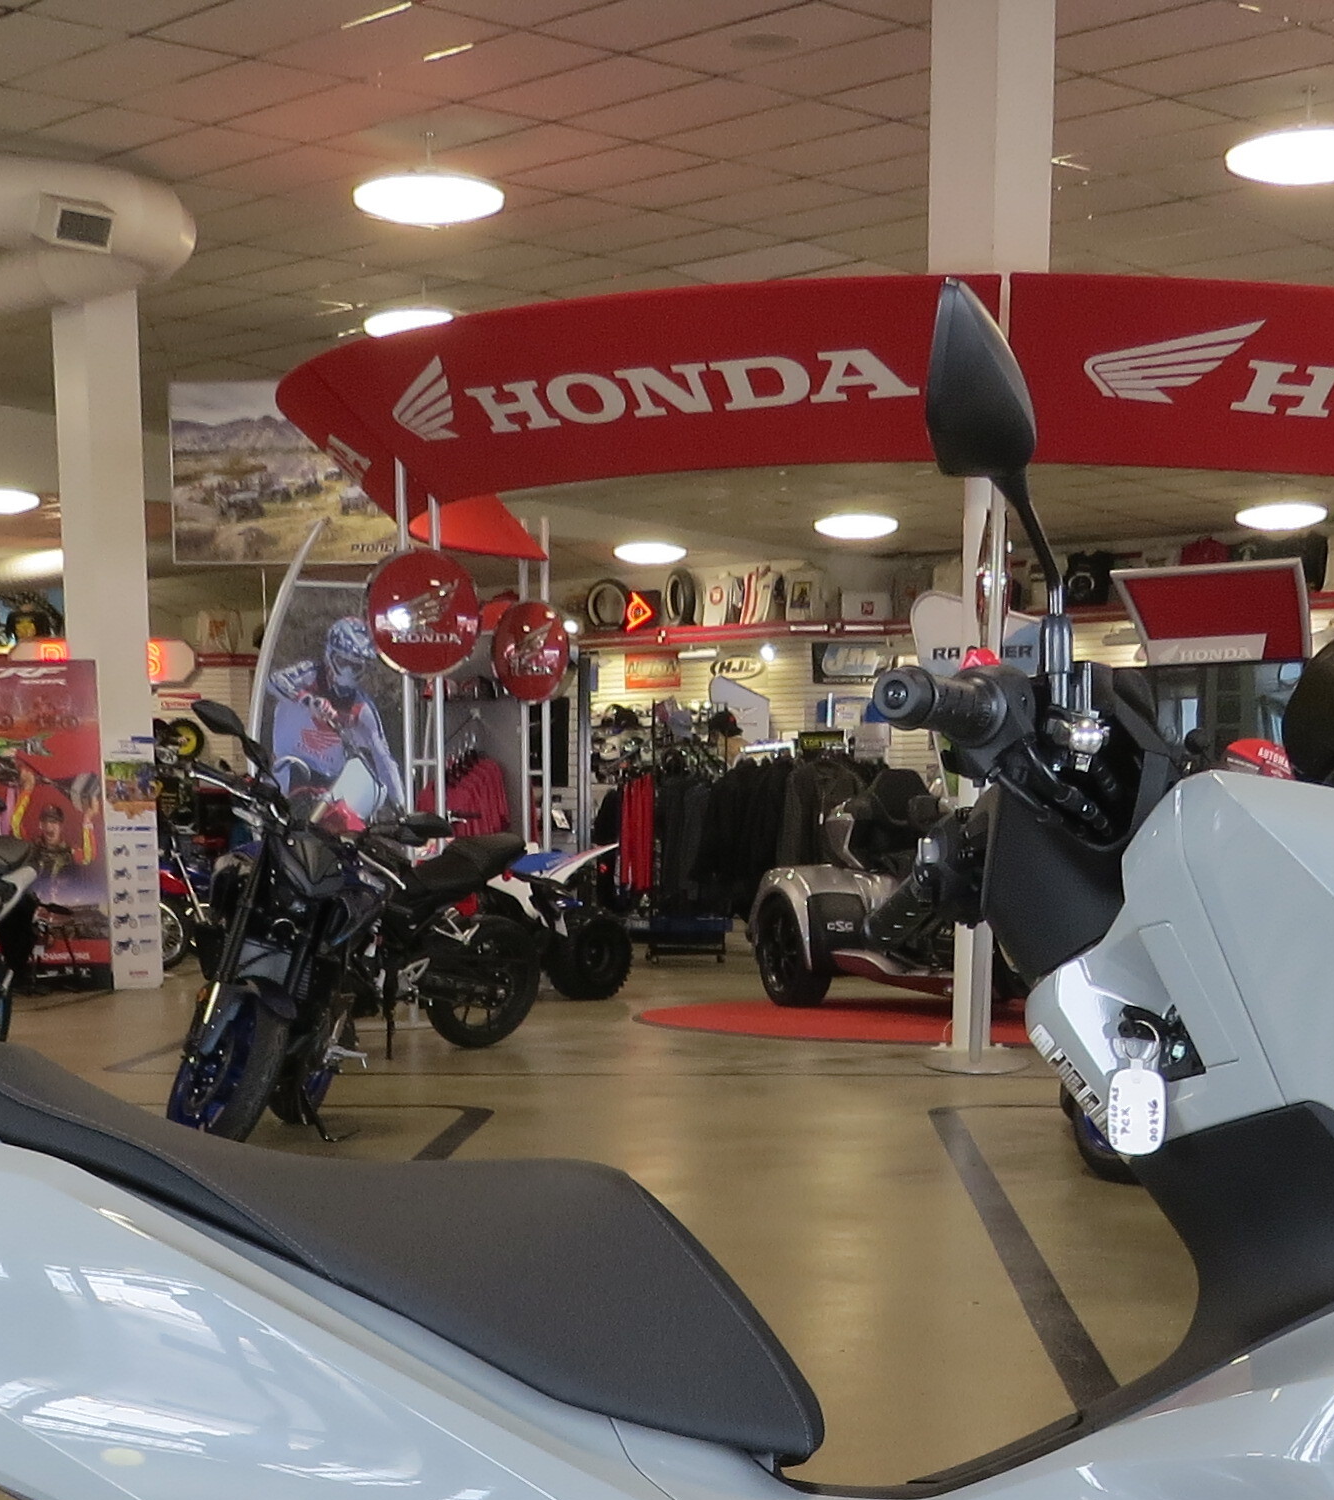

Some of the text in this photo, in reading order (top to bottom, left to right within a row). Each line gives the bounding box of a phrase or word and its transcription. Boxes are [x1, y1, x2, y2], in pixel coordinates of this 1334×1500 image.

[466, 348, 920, 434] HONDA
[351, 543, 414, 553] PIONE
[391, 632, 462, 645] HONDA
[1178, 645, 1253, 662] HONDA
[718, 660, 757, 673] HJC
[1257, 746, 1290, 769] AUTOMA
[1120, 1106, 1132, 1136] PCX
